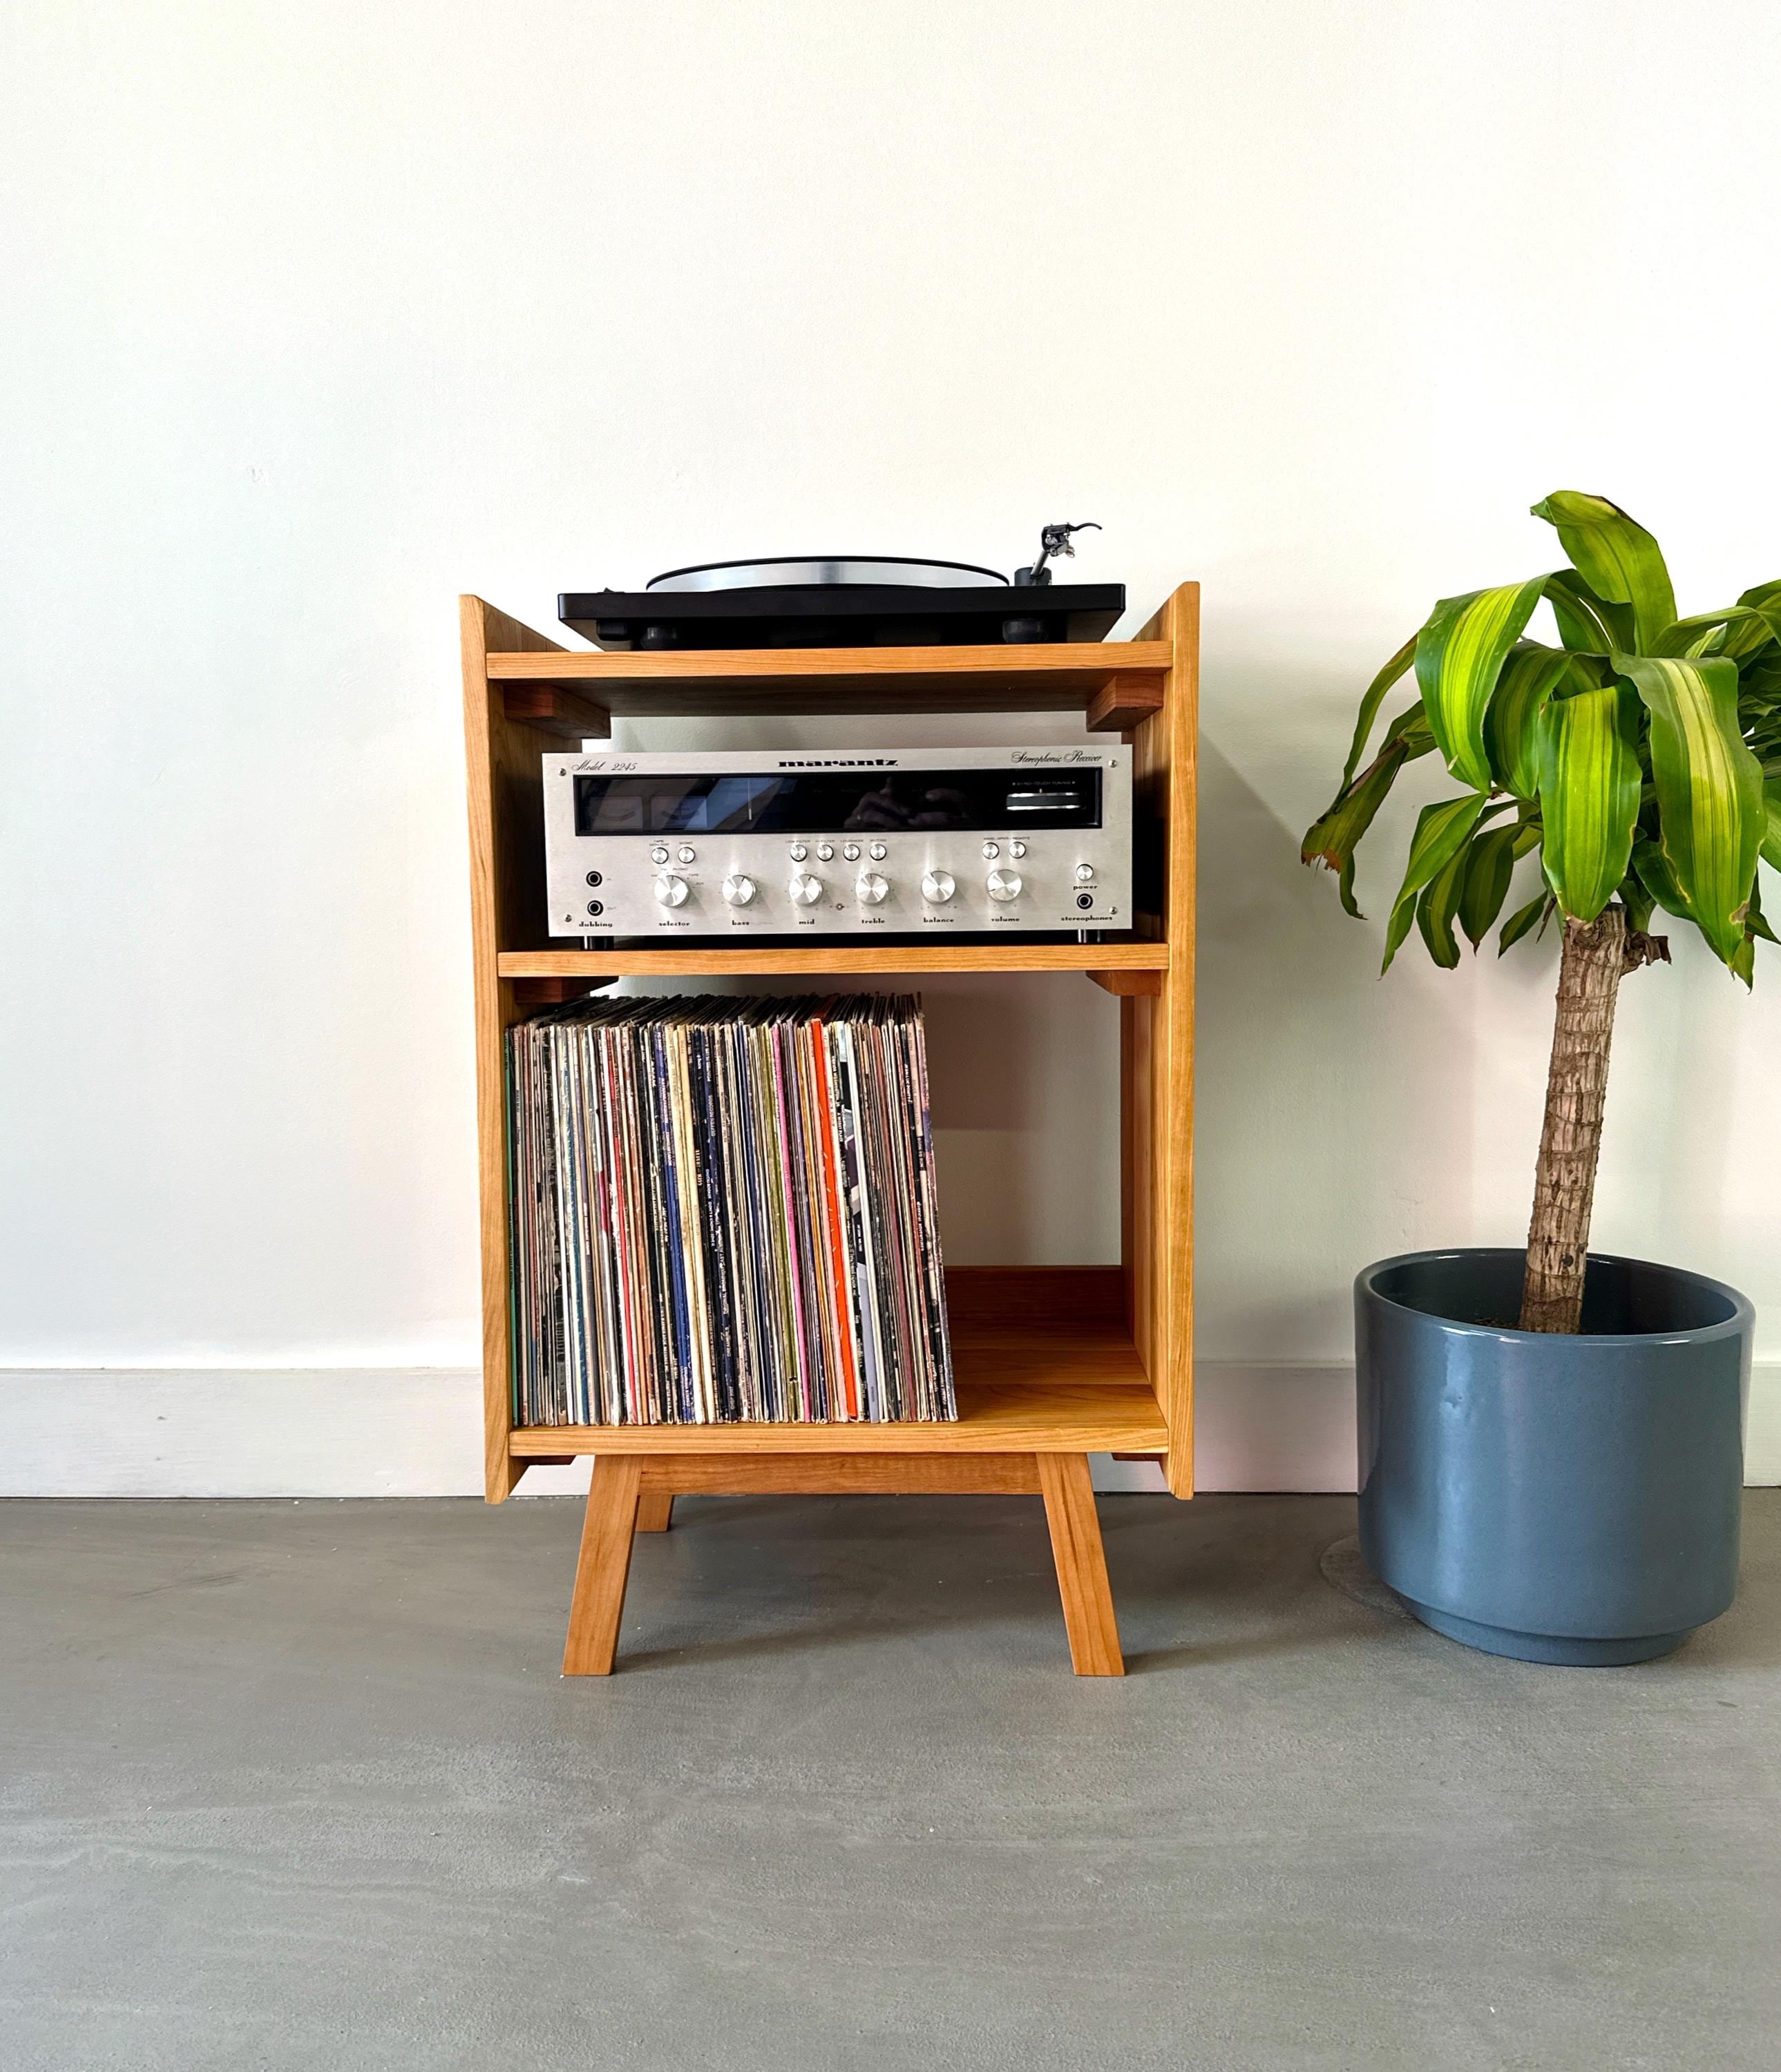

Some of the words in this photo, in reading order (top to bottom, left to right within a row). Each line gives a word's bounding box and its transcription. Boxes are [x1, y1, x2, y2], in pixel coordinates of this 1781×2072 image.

[778, 758, 898, 767] marantz
[1011, 751, 1062, 766] Stereophonic
[1064, 750, 1103, 762] Receiver
[572, 760, 604, 771] Model
[611, 762, 638, 771] 2245
[1060, 914, 1112, 923] stereophones
